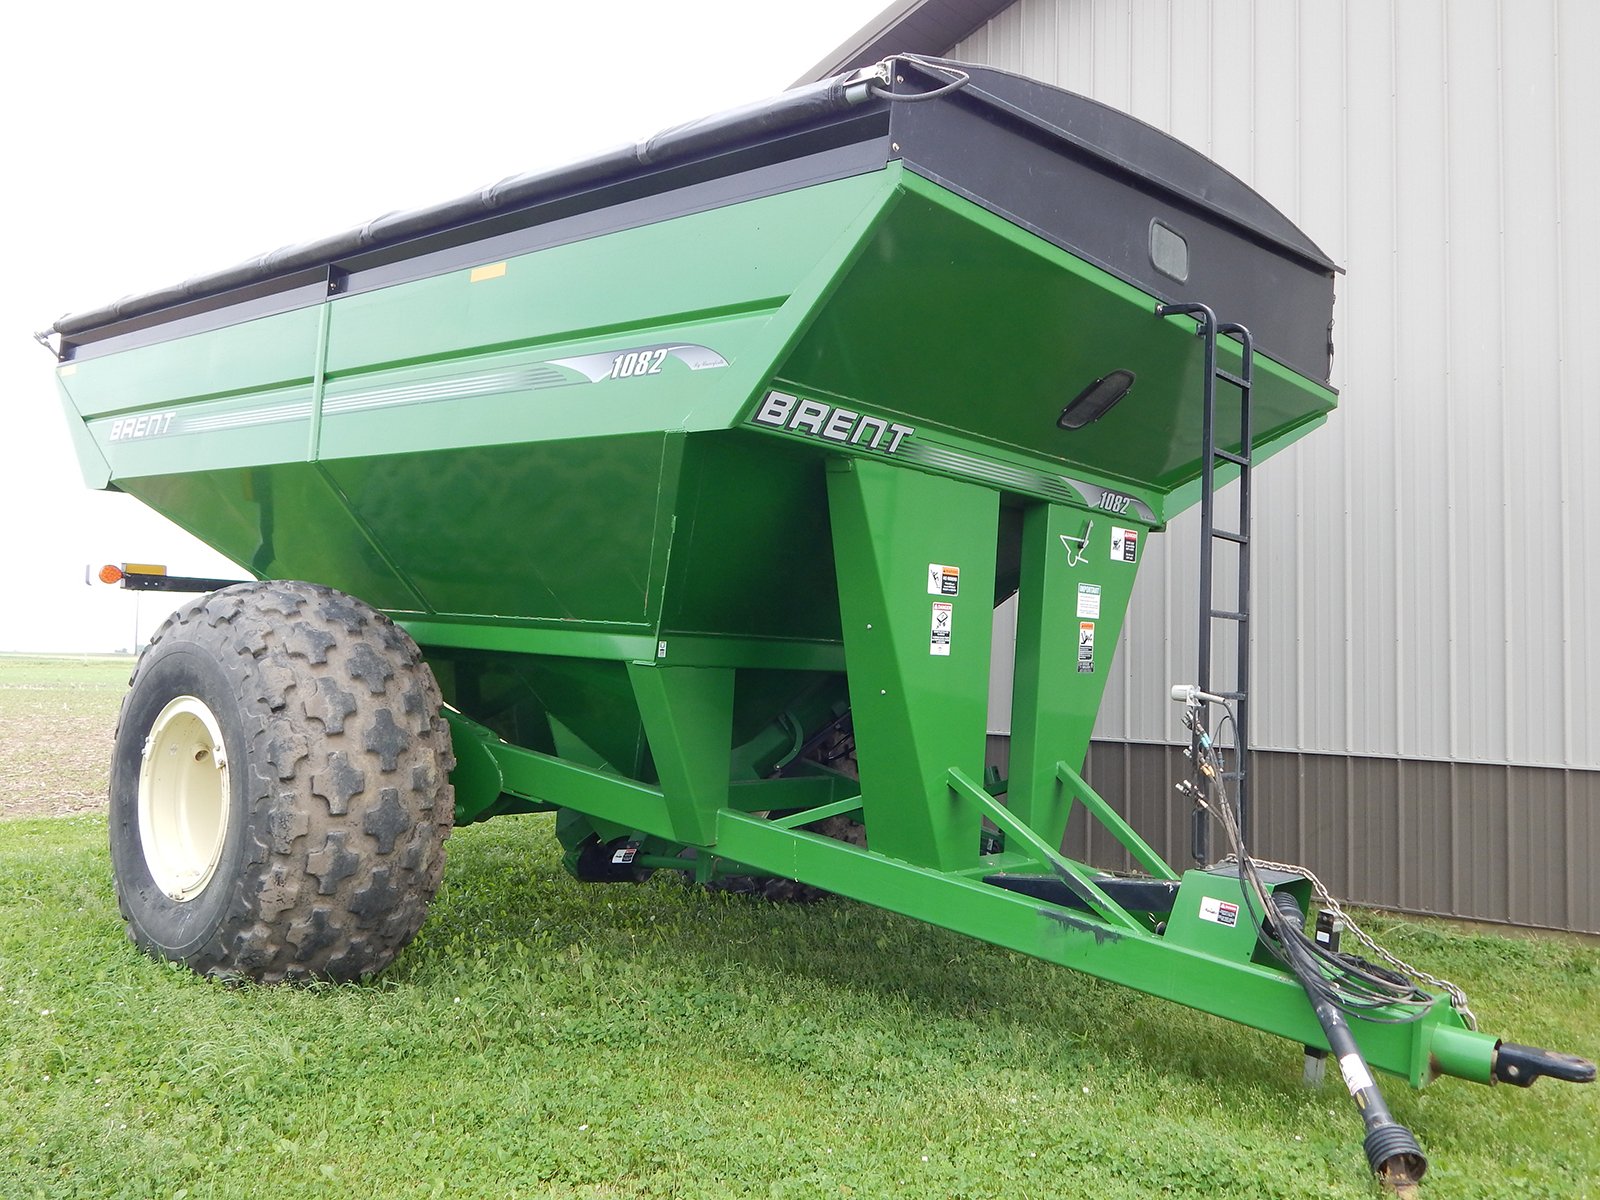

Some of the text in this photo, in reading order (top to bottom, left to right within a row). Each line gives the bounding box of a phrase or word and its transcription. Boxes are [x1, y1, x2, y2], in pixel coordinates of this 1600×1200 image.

[610, 348, 668, 379] 1082
[109, 412, 176, 441] BRENT
[753, 390, 915, 454] BRENT
[1099, 491, 1131, 515] 1082
